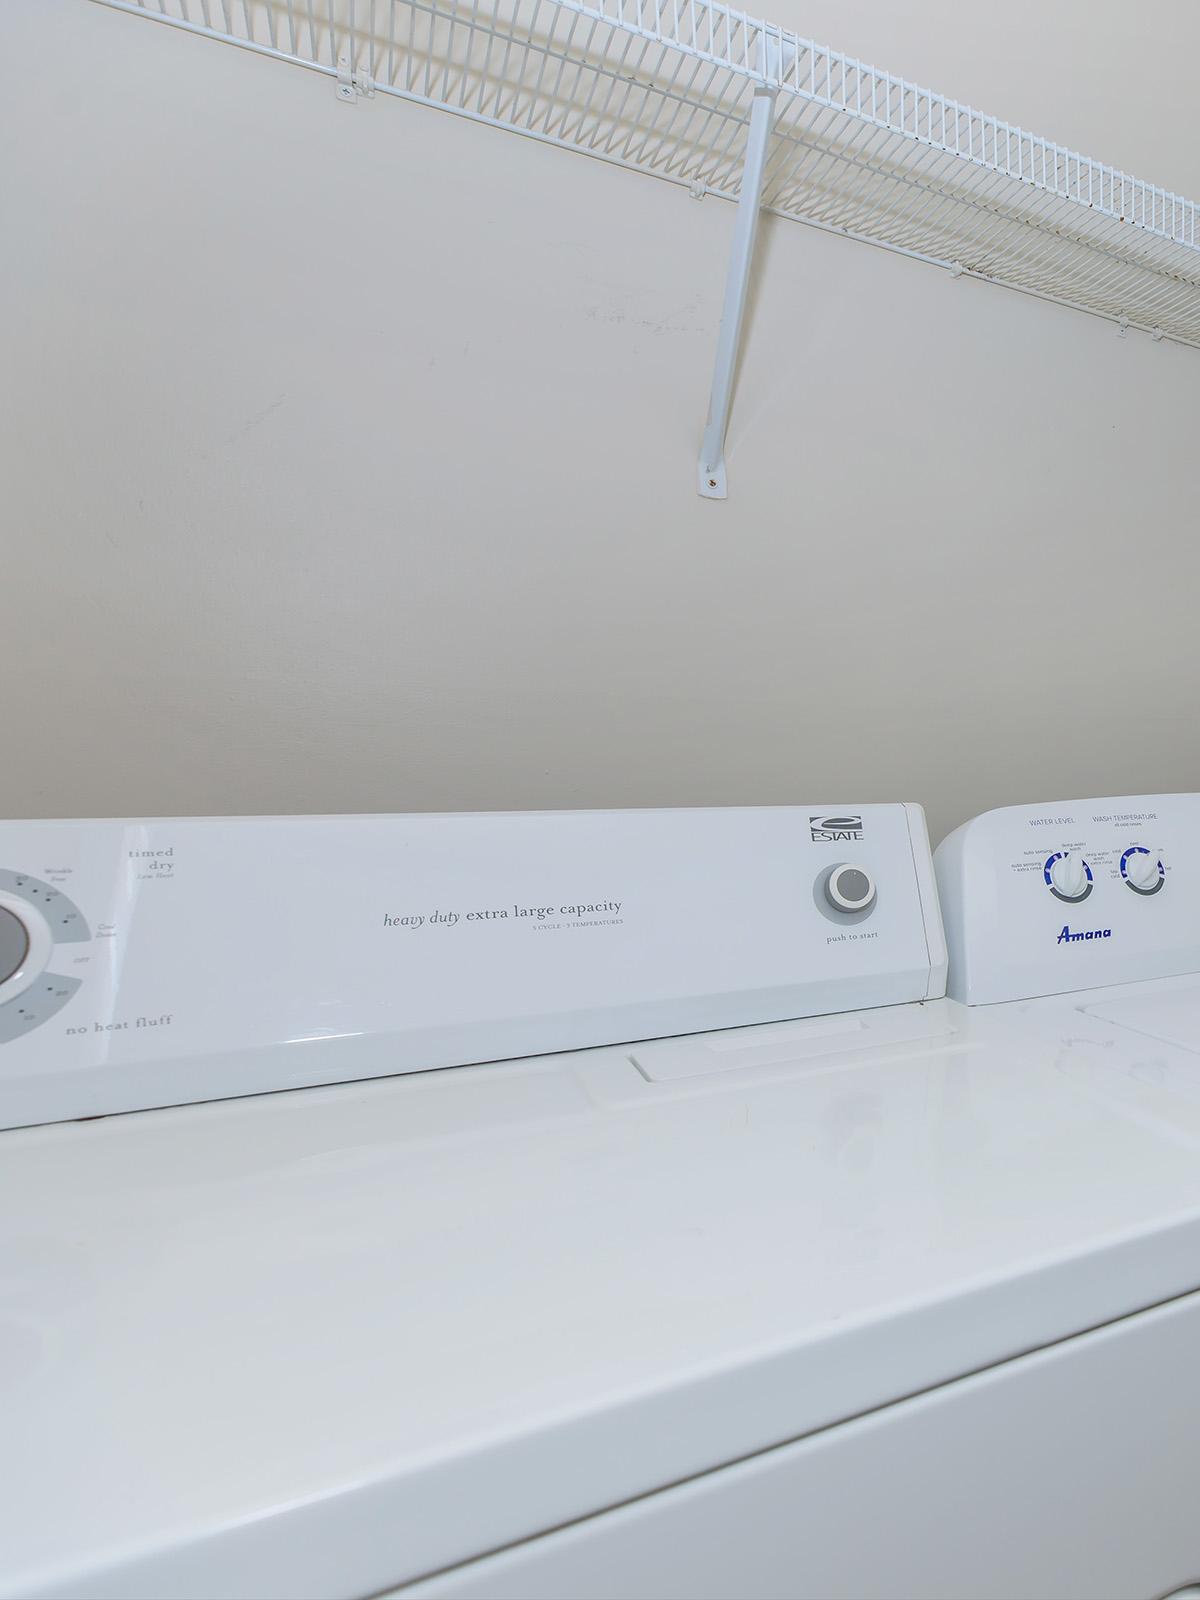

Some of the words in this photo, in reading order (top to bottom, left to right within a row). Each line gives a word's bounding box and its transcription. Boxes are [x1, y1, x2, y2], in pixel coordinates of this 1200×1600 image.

[1029, 819, 1053, 827] WATER
[1055, 817, 1076, 825] LEVEL
[1092, 815, 1112, 823] WASH
[1113, 813, 1158, 822] TEMPERATURE
[811, 831, 864, 842] ESTATE
[129, 847, 174, 858] timed
[149, 860, 174, 872] dry
[383, 913, 425, 930] heavy
[429, 910, 461, 927] duty
[466, 909, 508, 921] extra
[513, 905, 555, 920] large
[560, 899, 622, 917] capacity
[826, 933, 847, 944] push
[1057, 926, 1112, 945] Amana
[66, 1026, 88, 1035] no
[94, 1021, 129, 1033] heat
[136, 1014, 173, 1028] fluff
